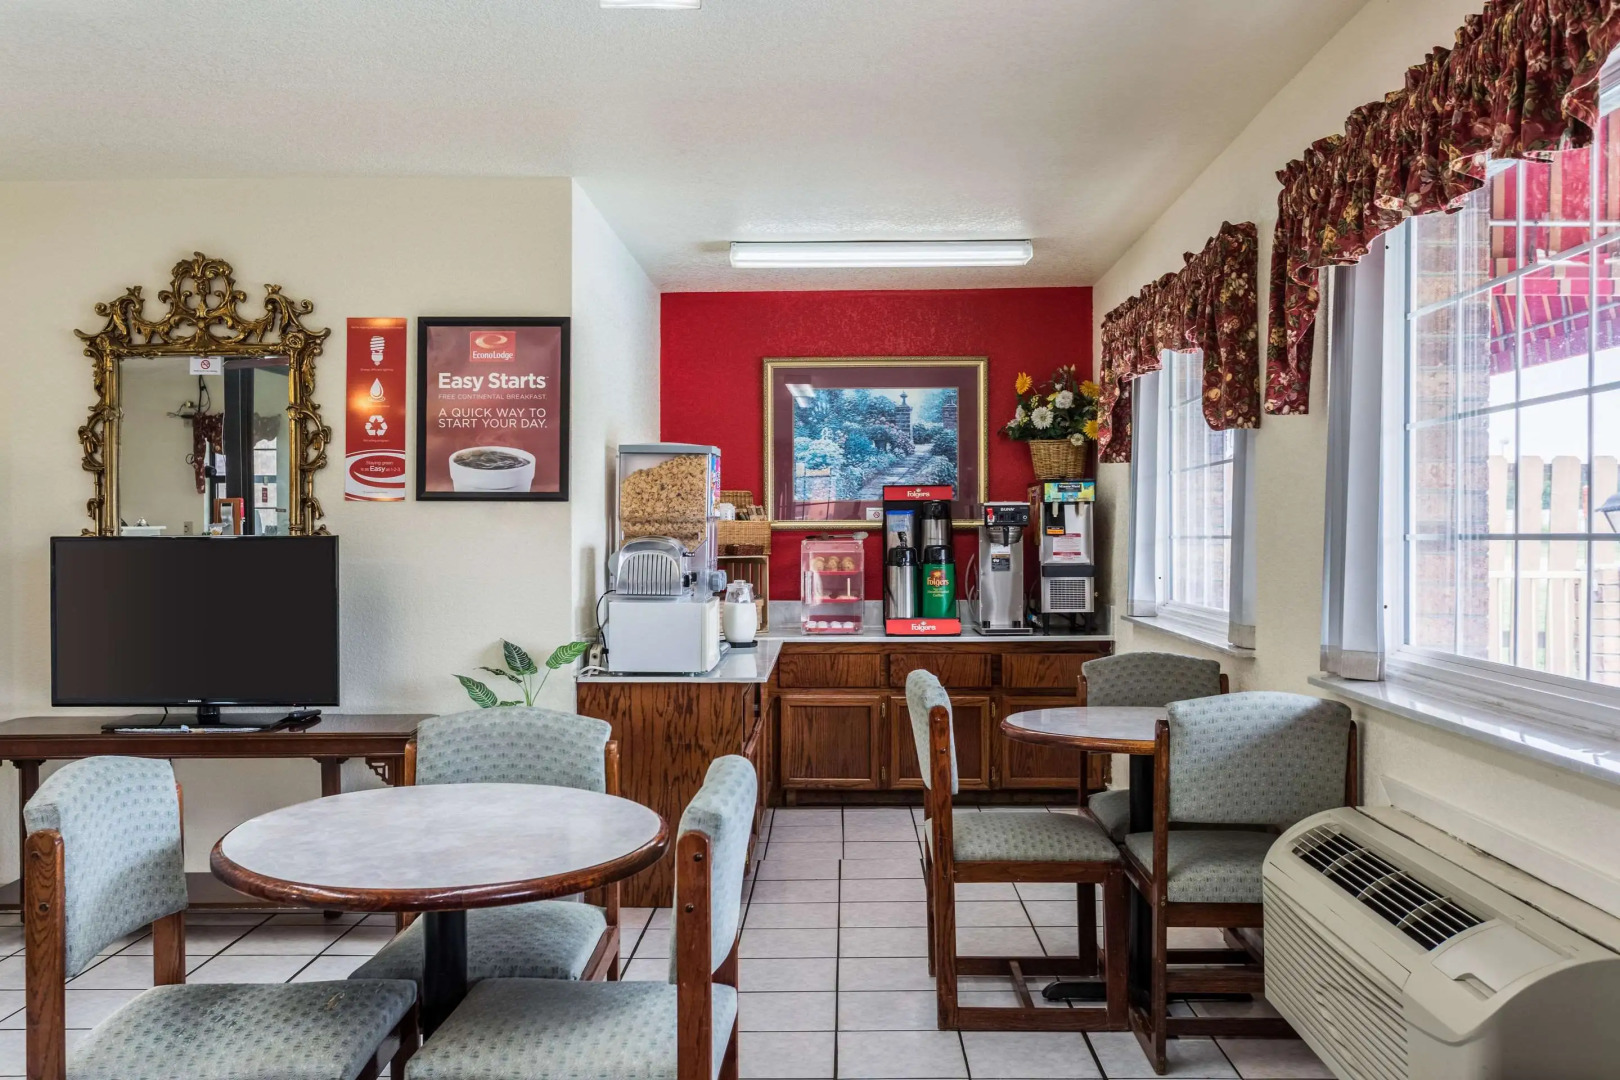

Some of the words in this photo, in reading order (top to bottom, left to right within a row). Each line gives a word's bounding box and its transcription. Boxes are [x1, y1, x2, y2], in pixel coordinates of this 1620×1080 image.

[472, 351, 514, 361] EconoLodge
[438, 372, 484, 392] Easy
[488, 372, 546, 389] Starts
[438, 407, 448, 418] A
[451, 407, 492, 418] QUICK
[496, 407, 525, 418] WAY
[529, 407, 546, 418] TO
[438, 418, 477, 429] START
[482, 418, 517, 429] YOUR
[521, 418, 548, 429] DAY.
[369, 465, 386, 473] Easy
[907, 490, 930, 498] Folgers
[926, 576, 950, 587] Folgers
[911, 623, 936, 632] Folgers
